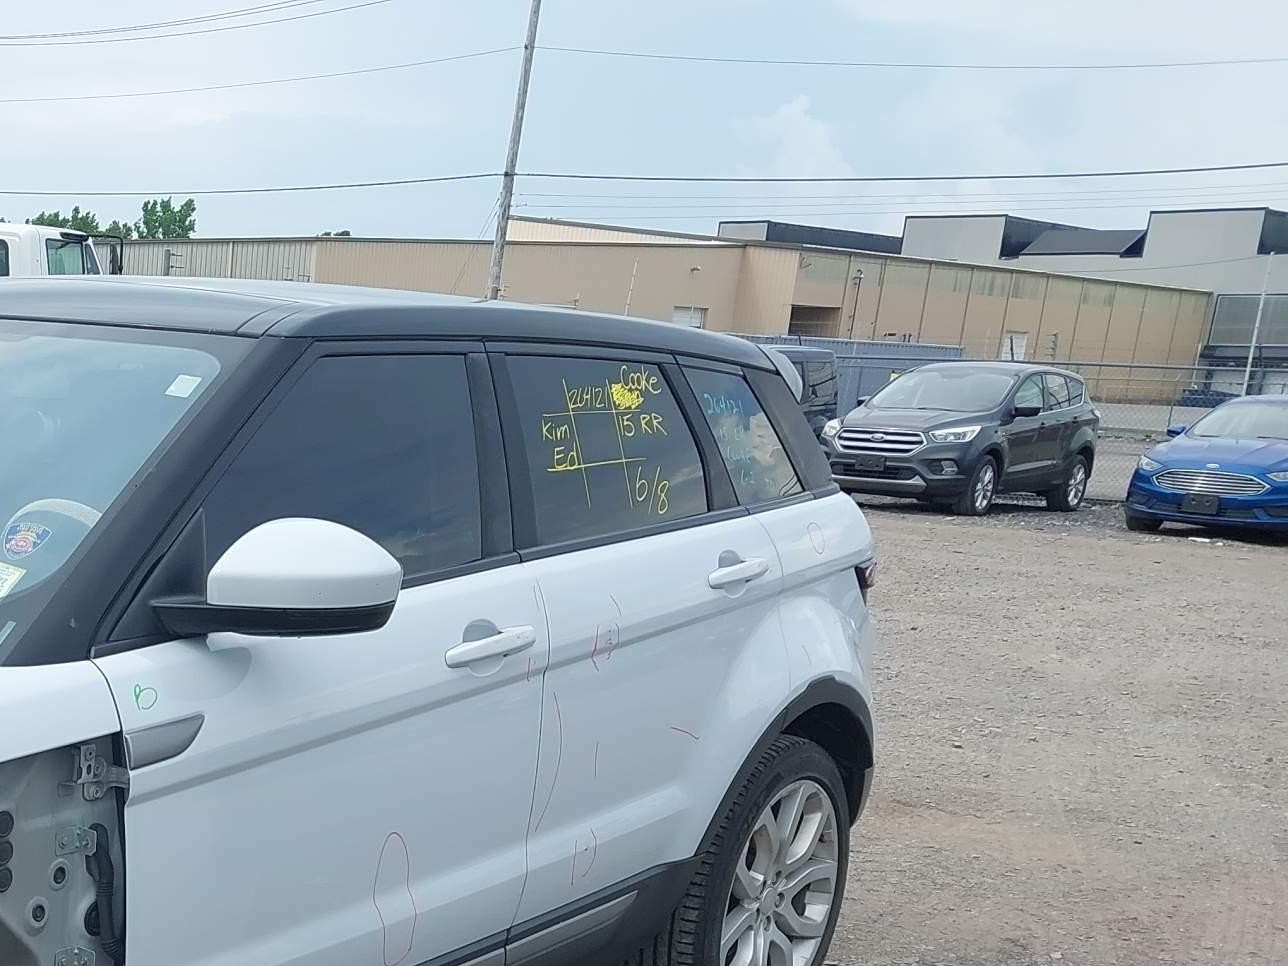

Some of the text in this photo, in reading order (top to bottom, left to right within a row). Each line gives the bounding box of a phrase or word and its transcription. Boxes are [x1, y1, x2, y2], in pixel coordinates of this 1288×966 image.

[620, 365, 662, 394] Cooke
[542, 419, 570, 441] Kim
[619, 413, 668, 437] 15 RR
[554, 441, 578, 470] Ed
[635, 465, 669, 514] 6/8
